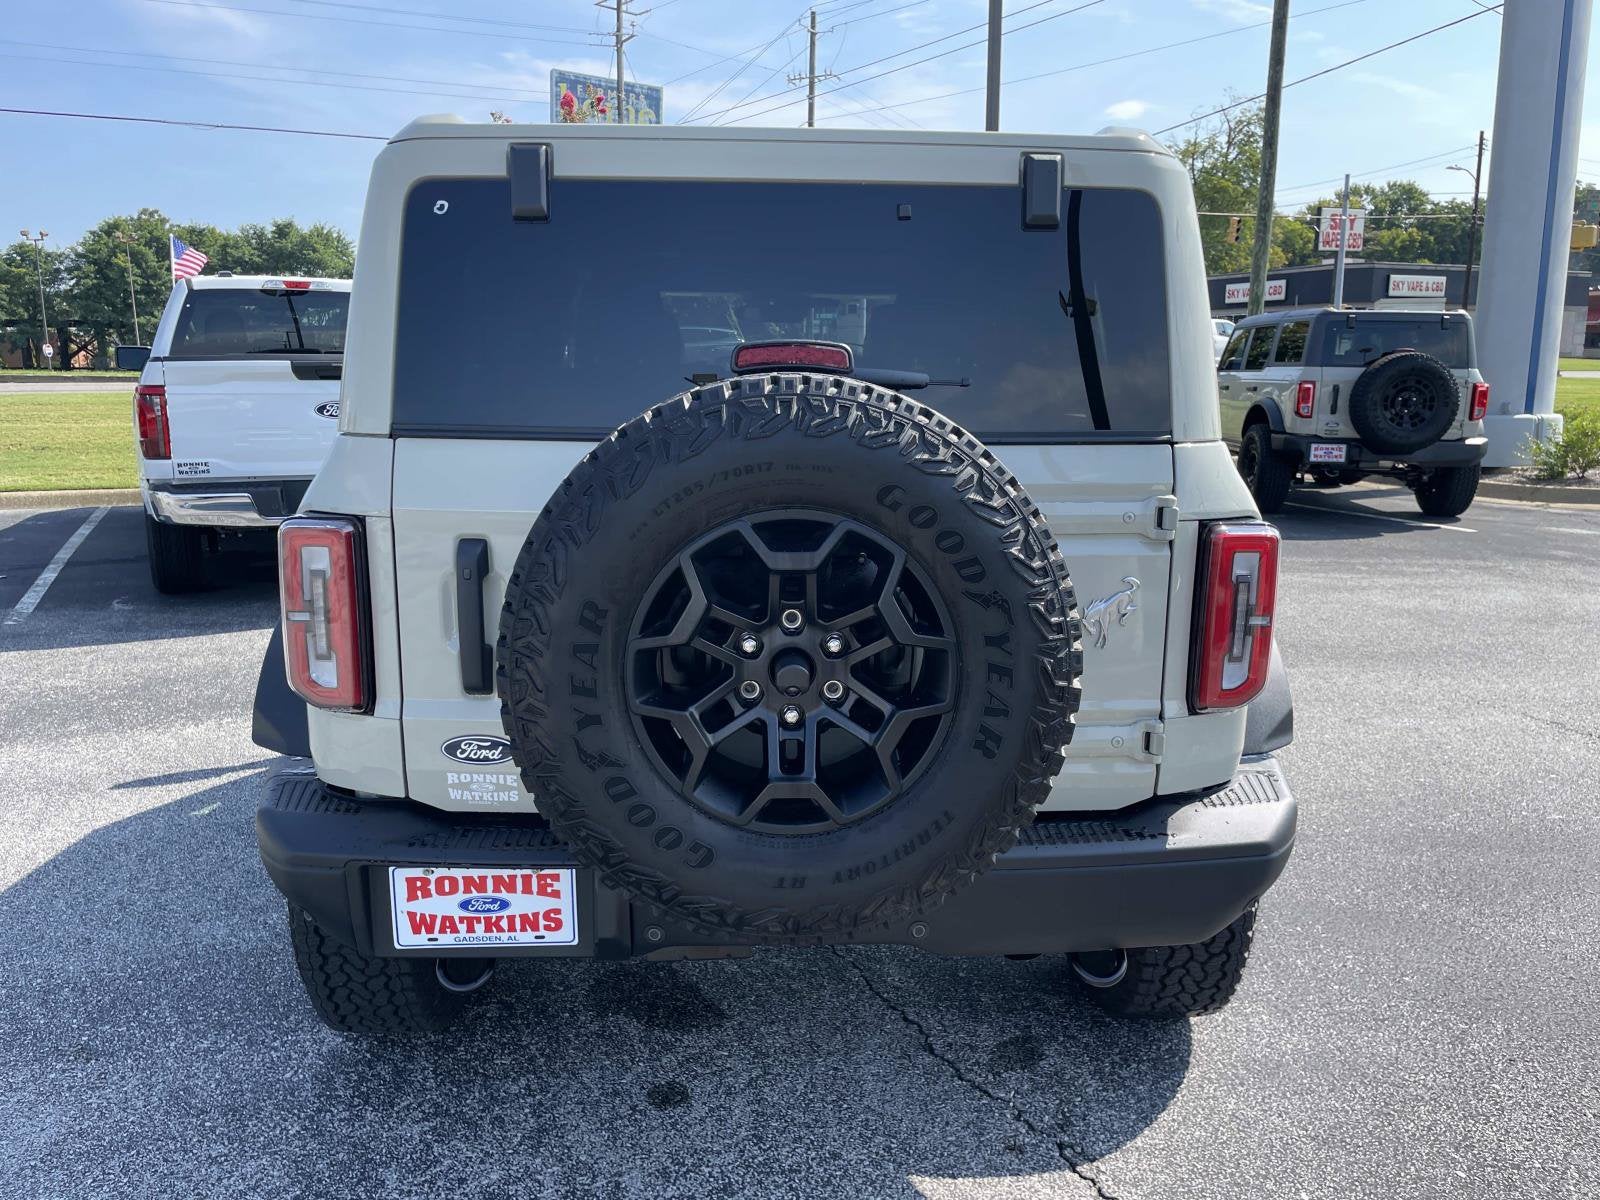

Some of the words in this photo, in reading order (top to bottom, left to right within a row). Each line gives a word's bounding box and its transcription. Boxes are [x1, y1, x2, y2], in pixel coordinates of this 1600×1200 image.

[1347, 232, 1361, 249] CBD
[1227, 287, 1240, 299] SKY
[1268, 284, 1283, 296] CBD
[1391, 280, 1405, 291] SKY
[1407, 281, 1424, 291] VAPE
[1424, 282, 1430, 291] &
[1431, 282, 1444, 293] CBD
[875, 483, 1018, 762] GOODYEAR
[569, 600, 716, 870] GOODYEAR
[456, 740, 503, 759] Ford
[447, 772, 518, 786] RONNIE
[448, 787, 519, 801] WATKINS
[405, 873, 562, 903] RONNIE
[468, 899, 501, 912] Ford
[406, 908, 564, 935] WATKINS
[454, 935, 504, 943] GADSDEN,
